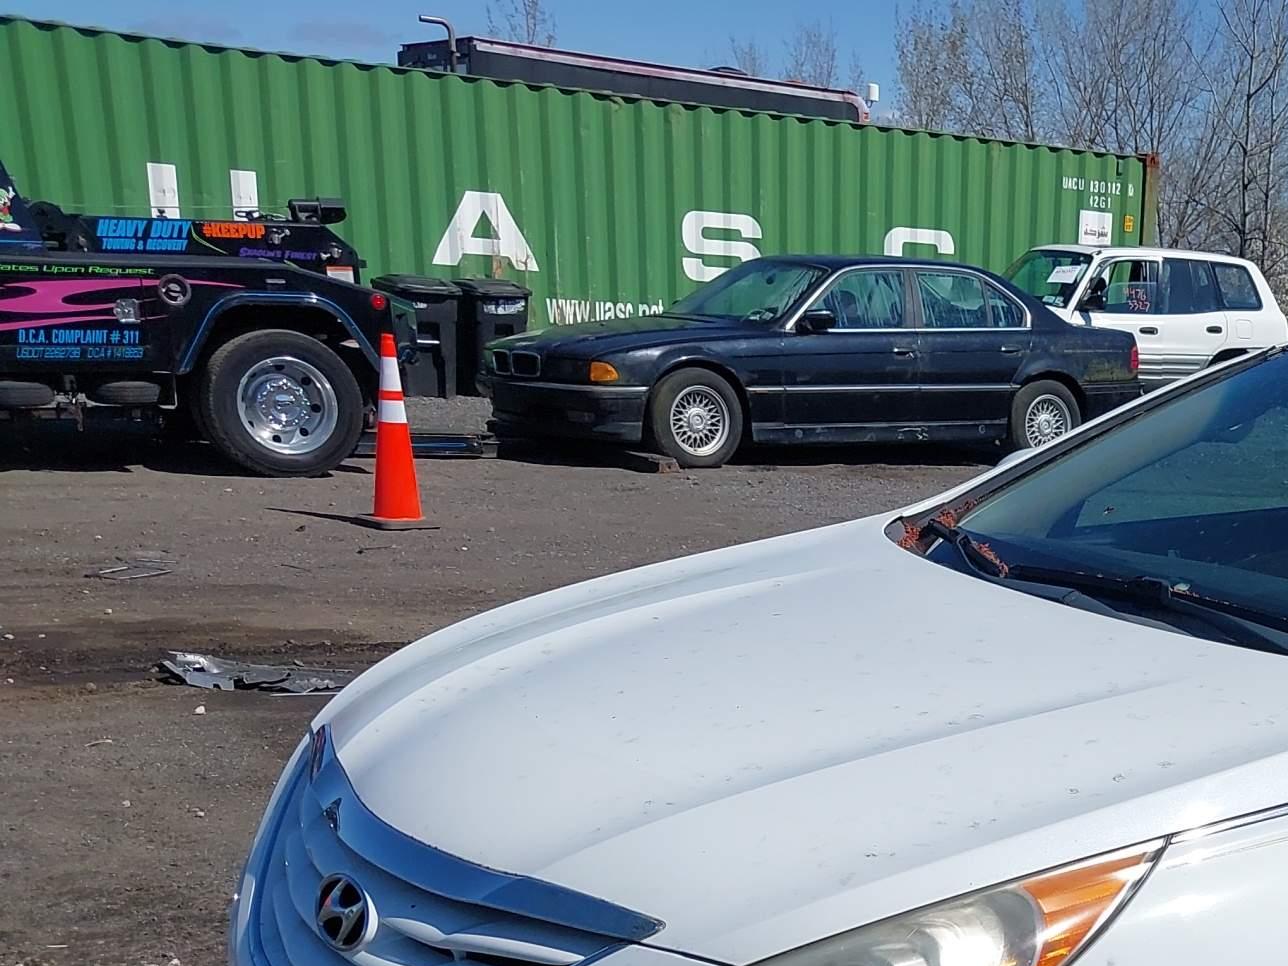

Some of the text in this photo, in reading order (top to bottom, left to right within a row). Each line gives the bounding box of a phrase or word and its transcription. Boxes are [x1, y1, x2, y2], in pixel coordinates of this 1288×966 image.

[96, 218, 193, 238] HEAVY DUTY
[203, 223, 265, 239] #KEEPUP
[102, 238, 189, 251] TOWING & RECOVERY
[0, 263, 156, 275] ates Upon Request
[18, 329, 49, 344] D.C.A.
[52, 329, 108, 344] COMPLAINT
[123, 330, 140, 344] 311
